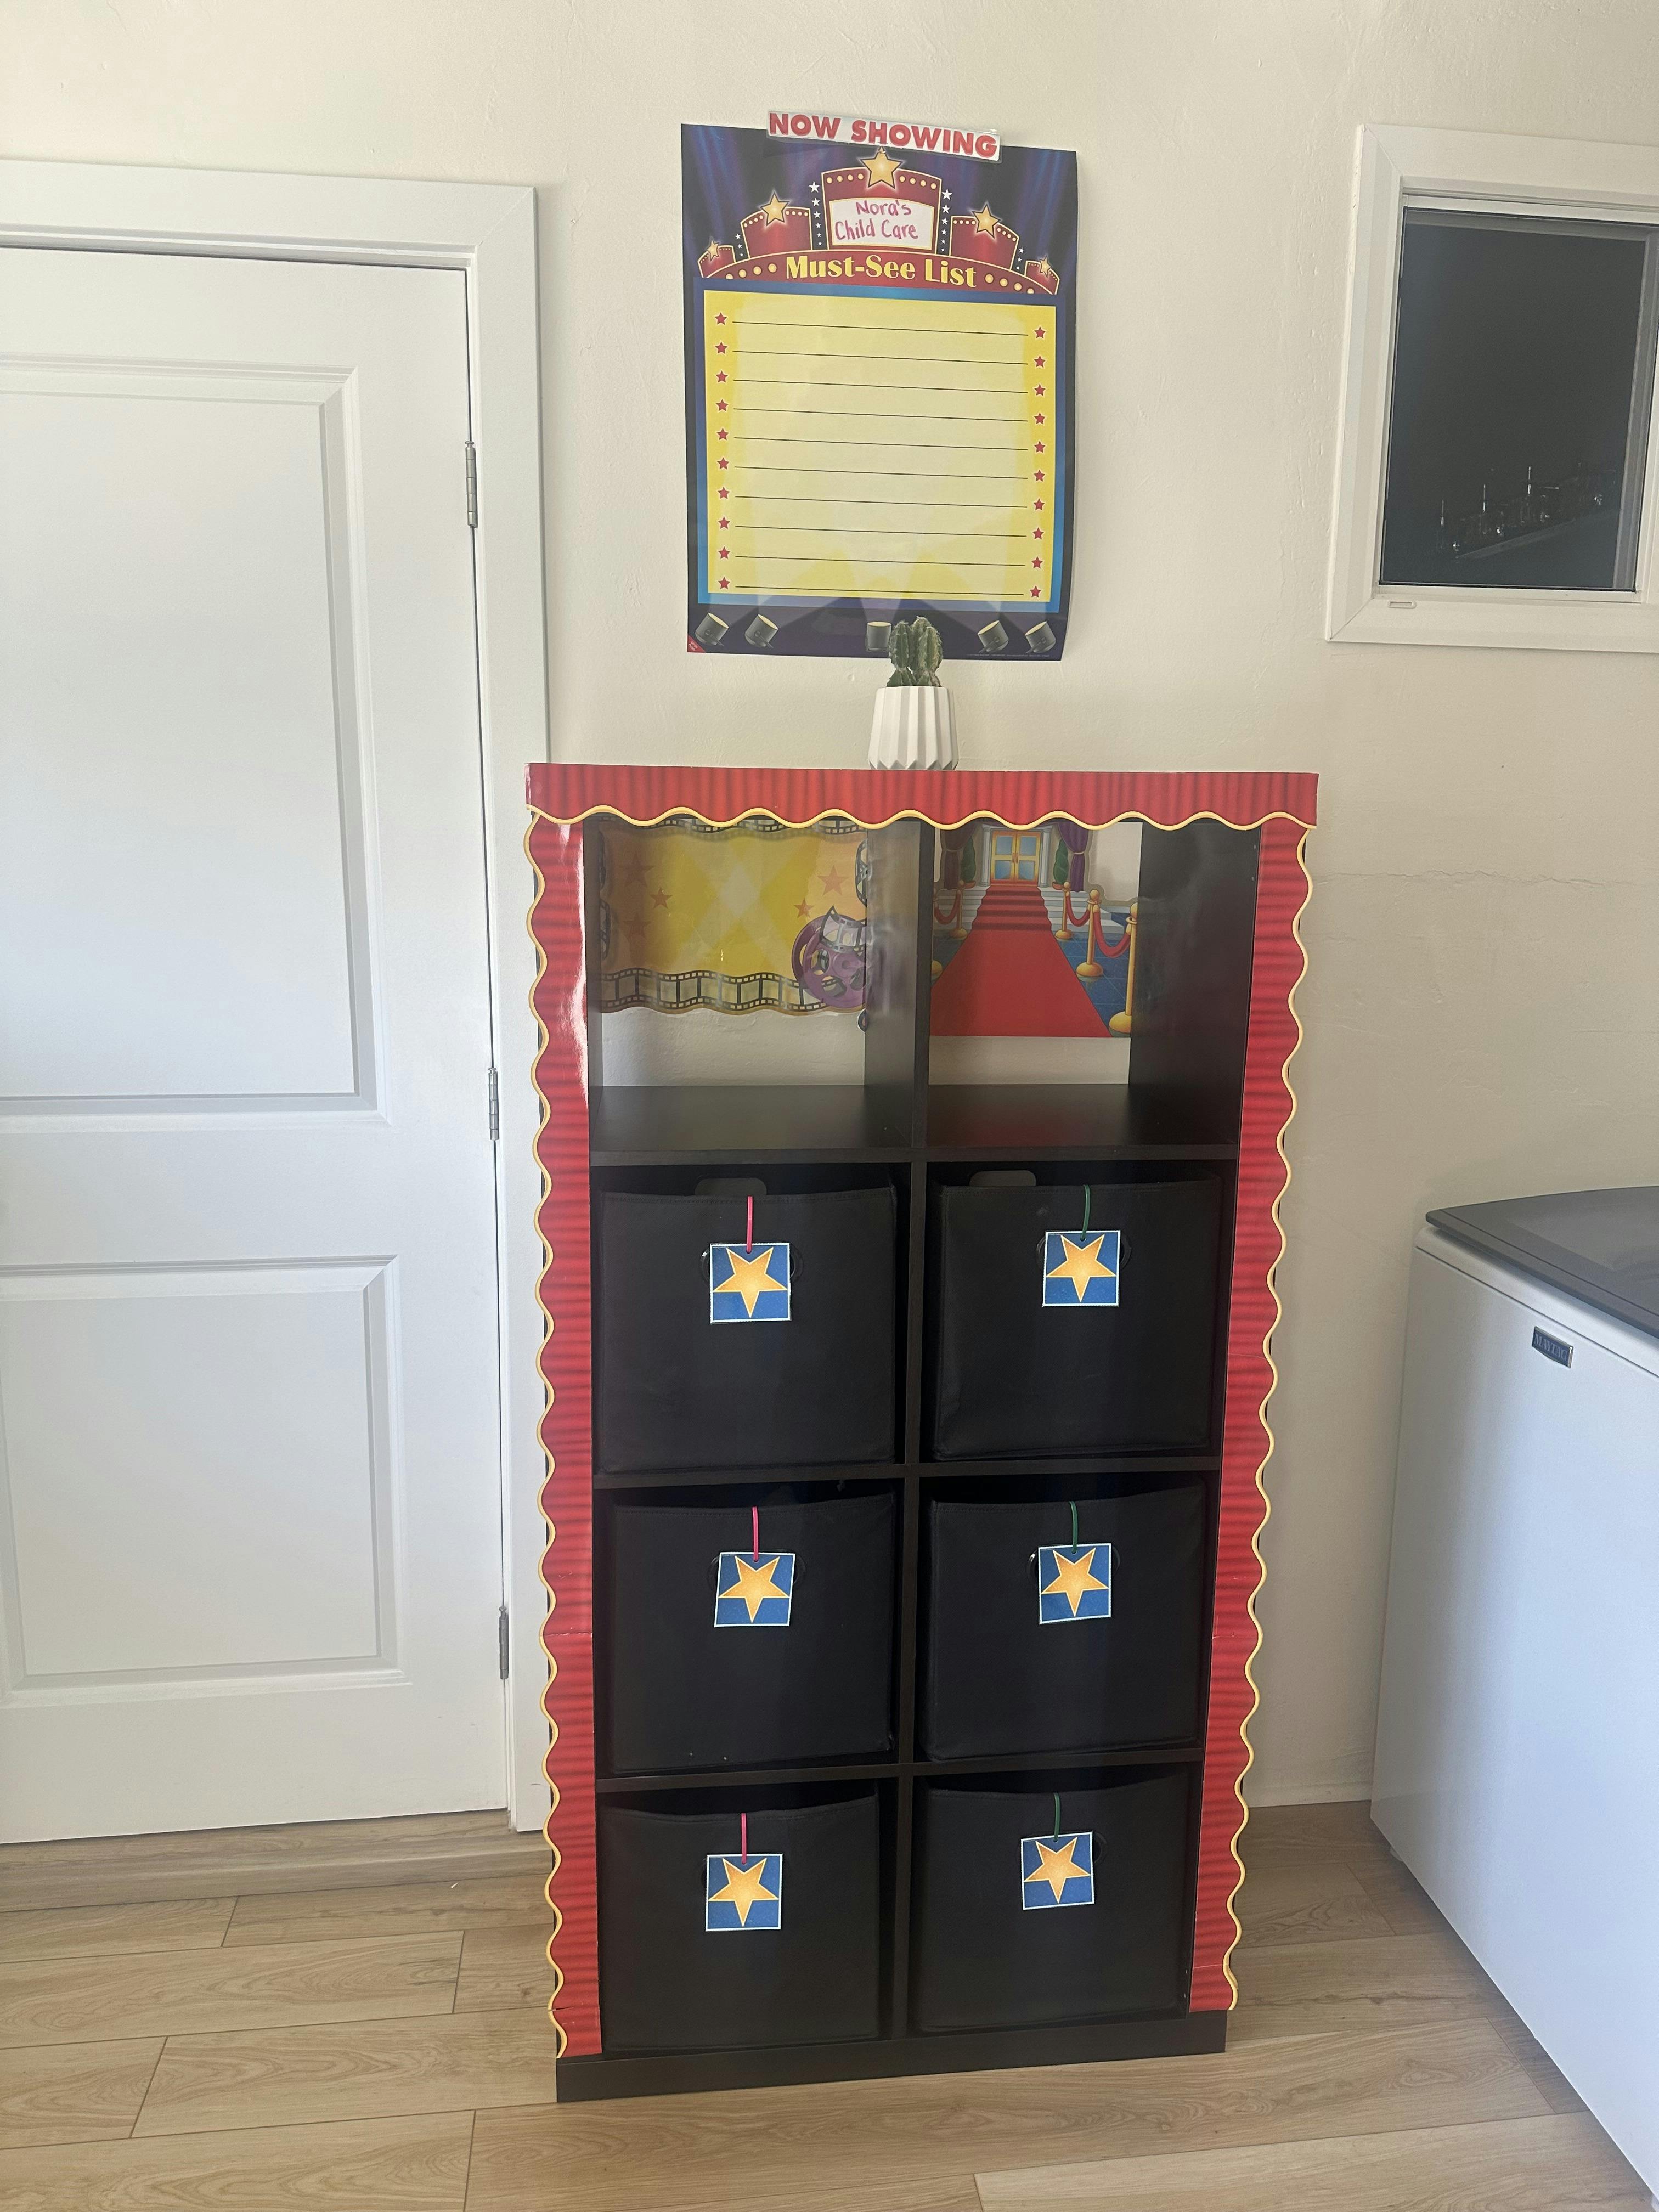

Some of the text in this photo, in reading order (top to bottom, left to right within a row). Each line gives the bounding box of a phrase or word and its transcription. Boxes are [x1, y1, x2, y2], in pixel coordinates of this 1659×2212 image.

[769, 113, 998, 158] NOW SHOWING
[856, 199, 911, 216] Nora's
[834, 220, 918, 240] Child Care
[786, 255, 977, 288] Must-See List
[1534, 1334, 1567, 1361] MAYTAG
